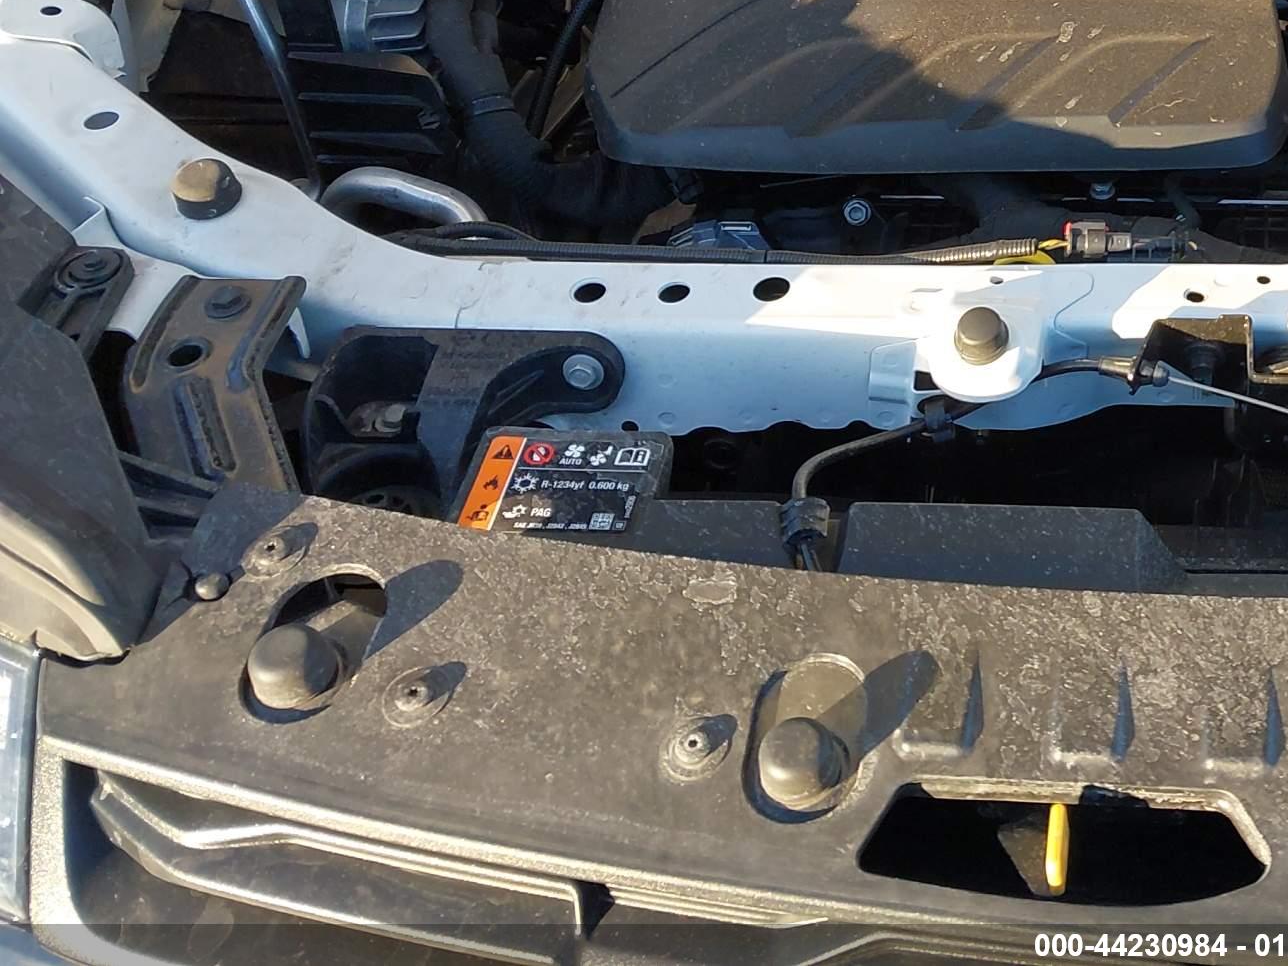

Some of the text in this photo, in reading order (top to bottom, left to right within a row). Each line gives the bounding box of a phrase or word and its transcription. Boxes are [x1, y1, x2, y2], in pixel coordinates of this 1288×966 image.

[559, 457, 582, 466] AUTO
[541, 480, 629, 492] R-1234yf 0.600 kg
[530, 507, 552, 517] PAG
